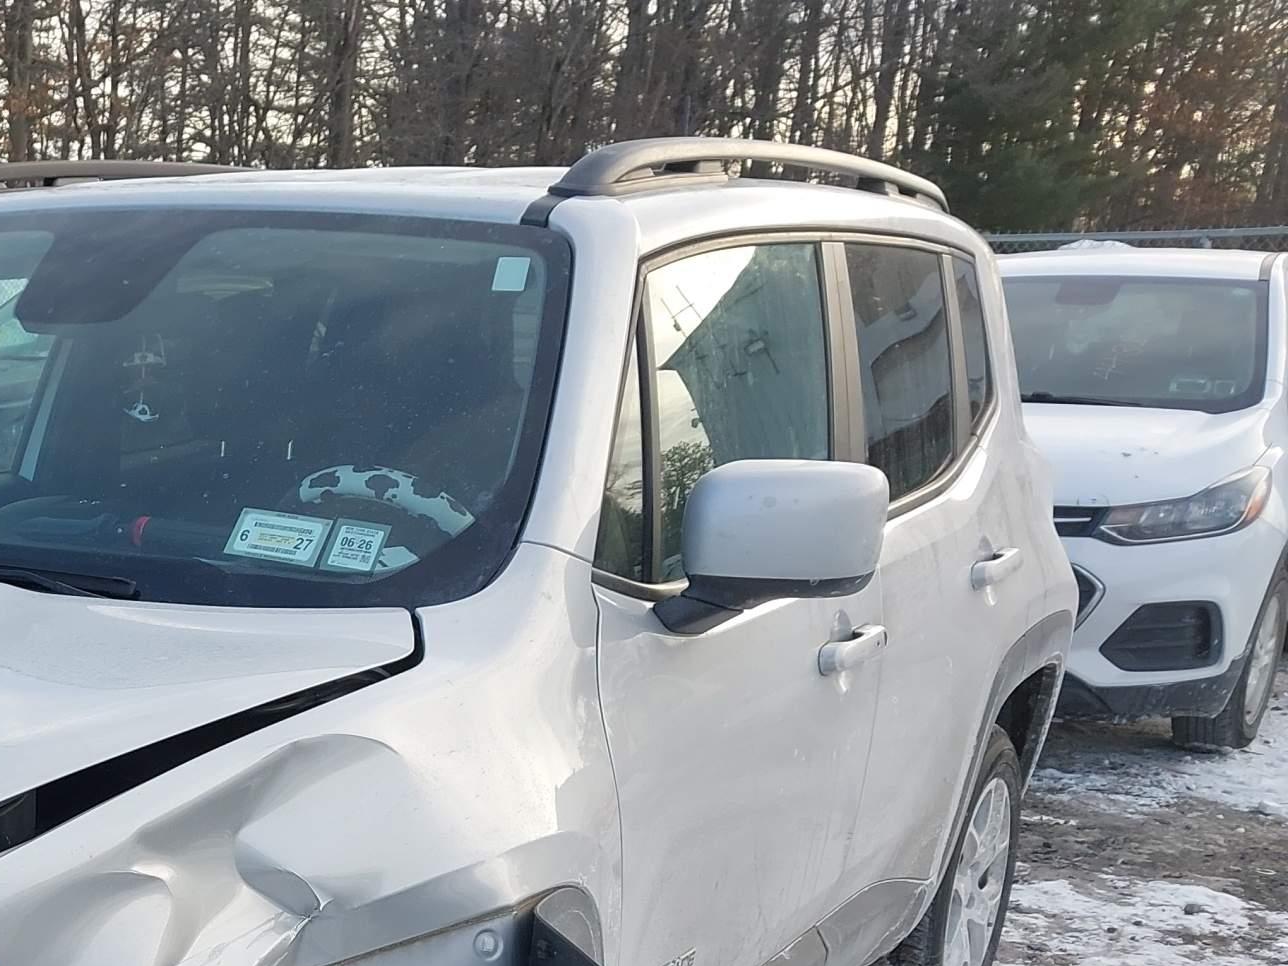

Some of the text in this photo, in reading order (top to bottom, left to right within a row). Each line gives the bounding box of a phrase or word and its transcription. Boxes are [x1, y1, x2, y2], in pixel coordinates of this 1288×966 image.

[239, 529, 251, 542] 6
[292, 537, 314, 551] 27
[340, 536, 356, 548] 06
[357, 538, 374, 551] 26
